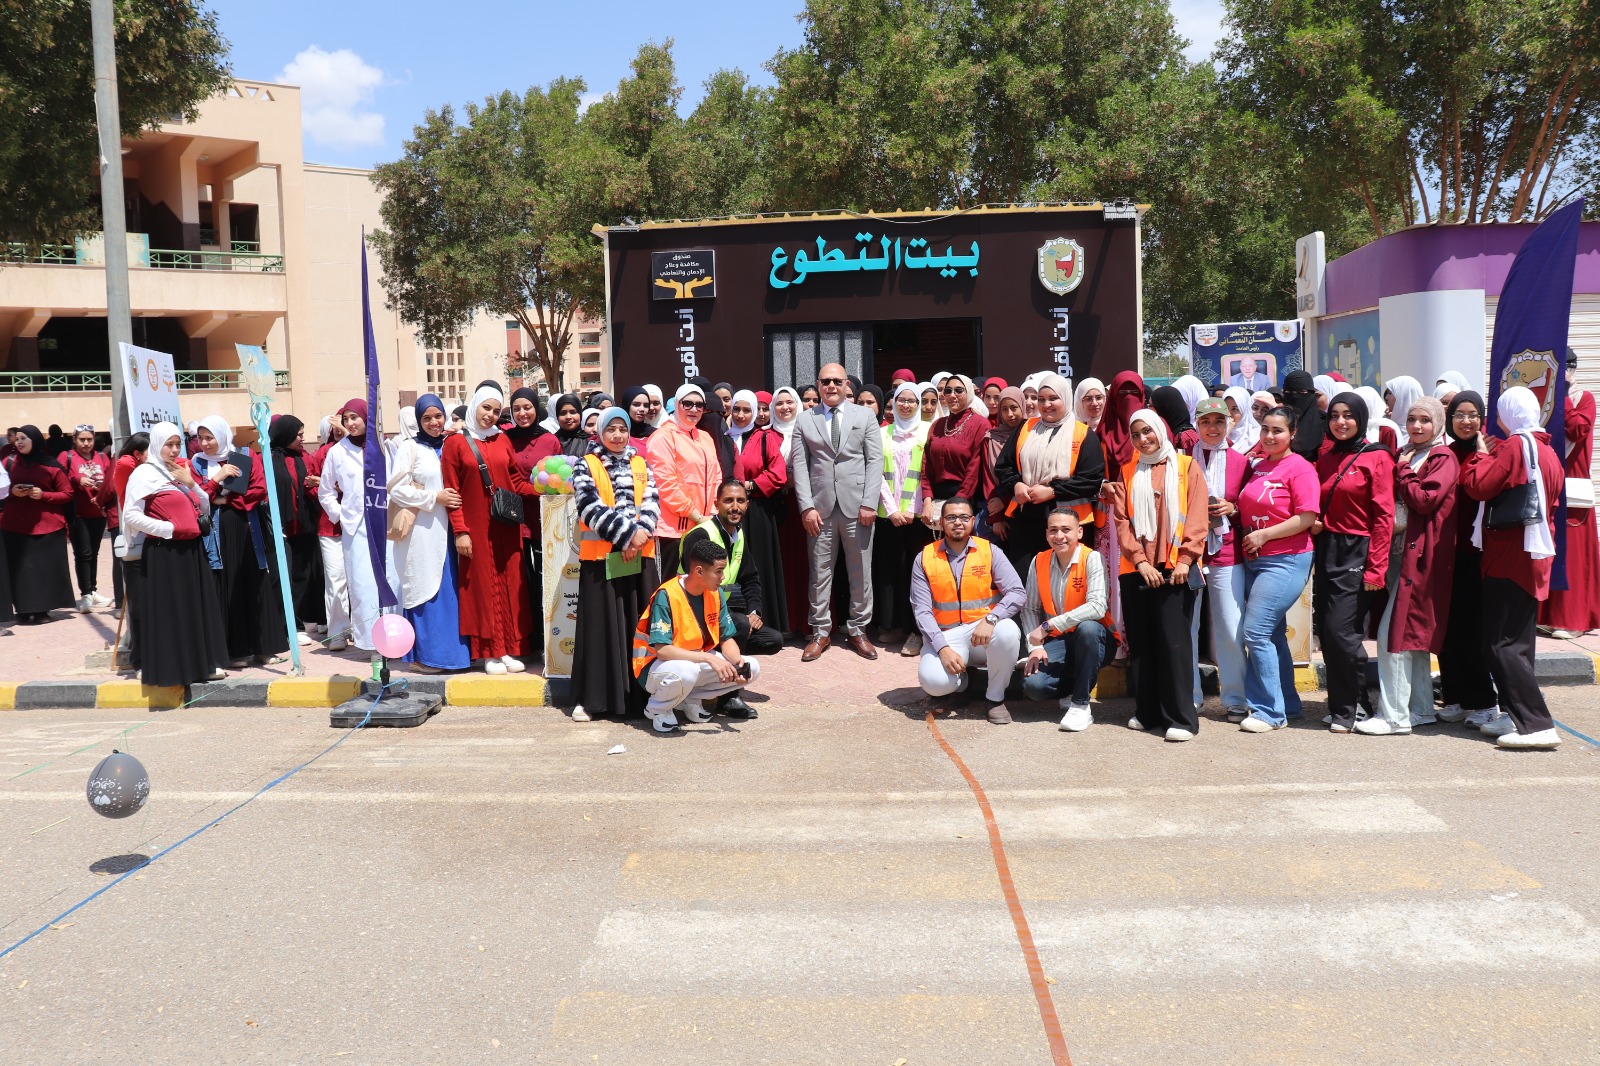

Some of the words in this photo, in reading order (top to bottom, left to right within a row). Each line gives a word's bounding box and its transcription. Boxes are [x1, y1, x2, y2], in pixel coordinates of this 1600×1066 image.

[664, 262, 679, 270] وعلاج
[769, 232, 901, 289] التطوع
[904, 237, 980, 278] بيت
[675, 308, 695, 342] أنت
[1049, 307, 1069, 341] أنت
[676, 346, 699, 384] أقو
[1050, 346, 1074, 389] أقو
